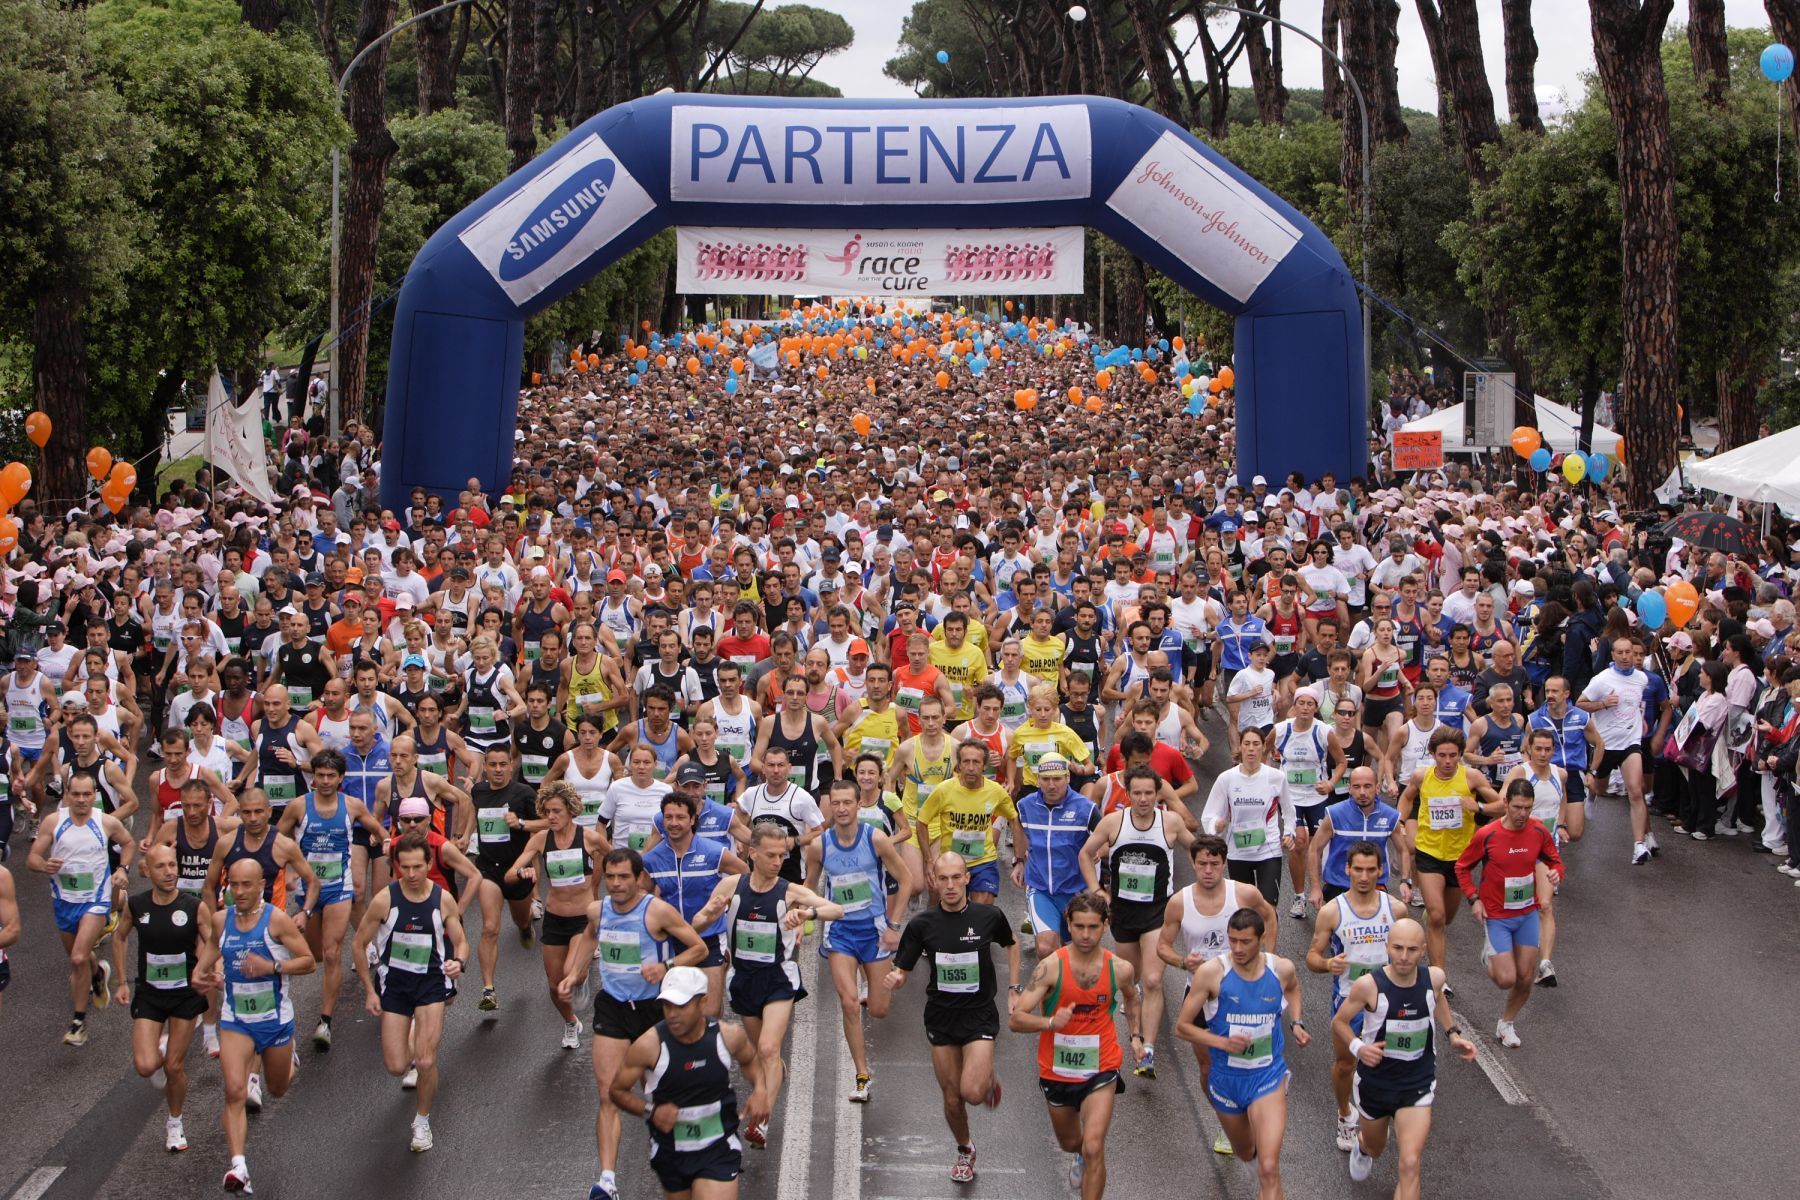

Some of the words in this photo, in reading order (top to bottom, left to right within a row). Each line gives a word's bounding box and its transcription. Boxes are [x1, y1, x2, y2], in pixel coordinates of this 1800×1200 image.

[690, 122, 1072, 185] PARTENZA
[505, 177, 610, 261] SAMSUNG
[1136, 161, 1204, 215] Johnson
[1202, 210, 1270, 265] Johnson
[859, 257, 920, 275] race
[883, 276, 929, 291] cure
[1029, 659, 1043, 669] DUE
[949, 811, 966, 823] DUE
[1430, 809, 1455, 820] 13253
[1353, 924, 1390, 937] ITALIA
[747, 936, 754, 949] 5
[610, 946, 621, 961] 47
[156, 967, 169, 978] 14
[942, 969, 967, 982] 1535
[1060, 1051, 1086, 1066] 1442
